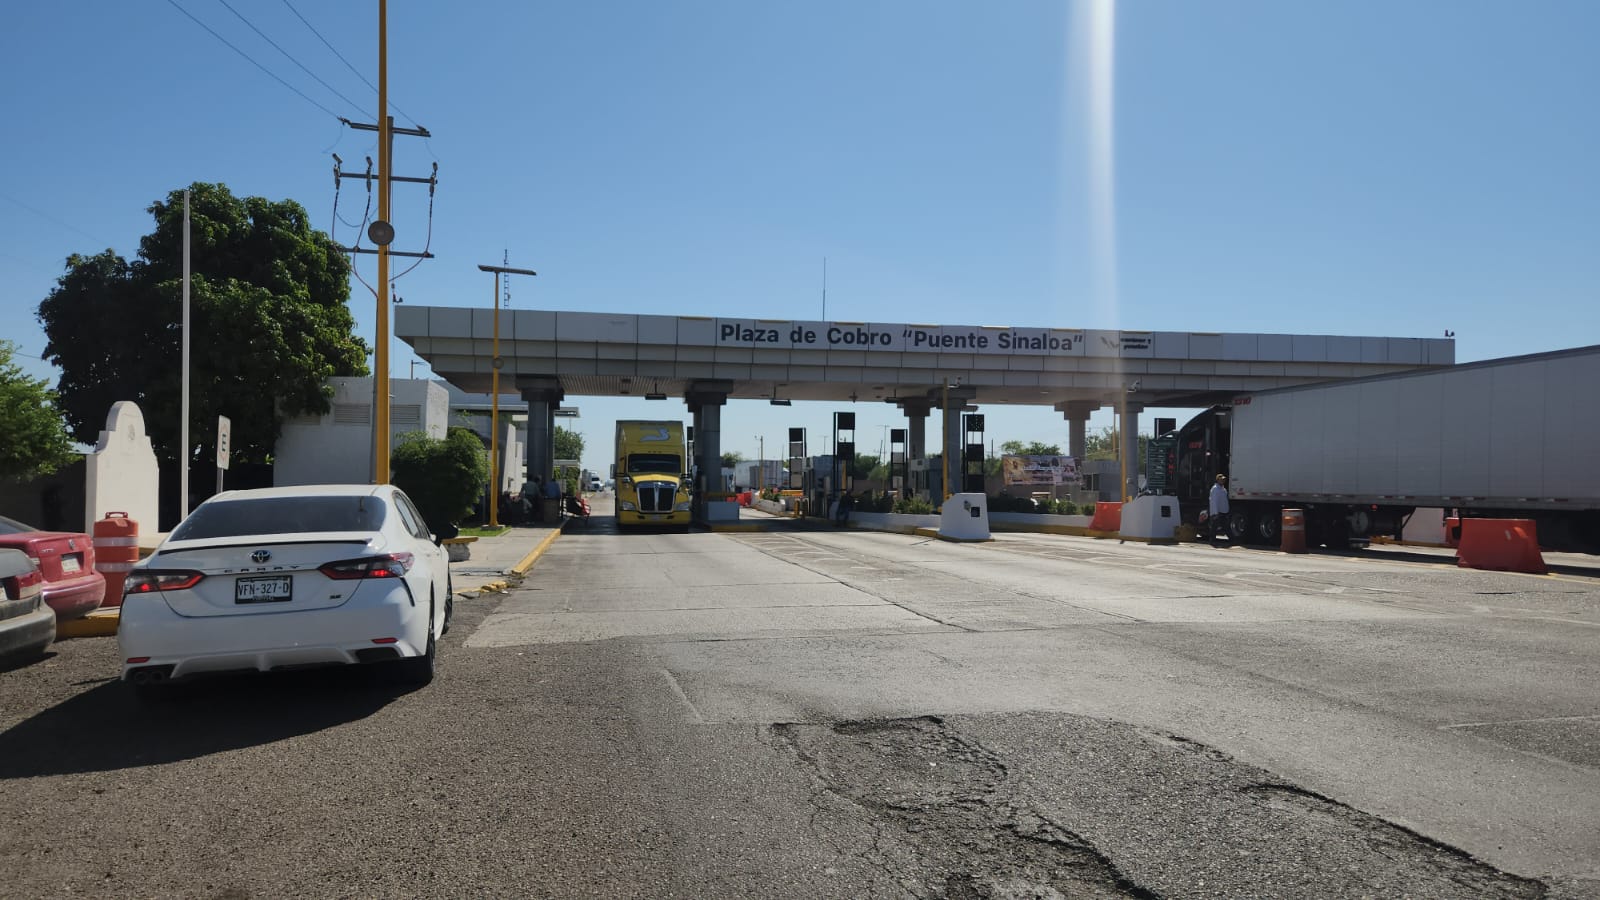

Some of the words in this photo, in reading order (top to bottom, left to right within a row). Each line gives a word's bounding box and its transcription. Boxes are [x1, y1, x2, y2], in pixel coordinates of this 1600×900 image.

[721, 324, 779, 343] Plaza
[789, 326, 817, 344] de
[827, 327, 892, 346] Cobro
